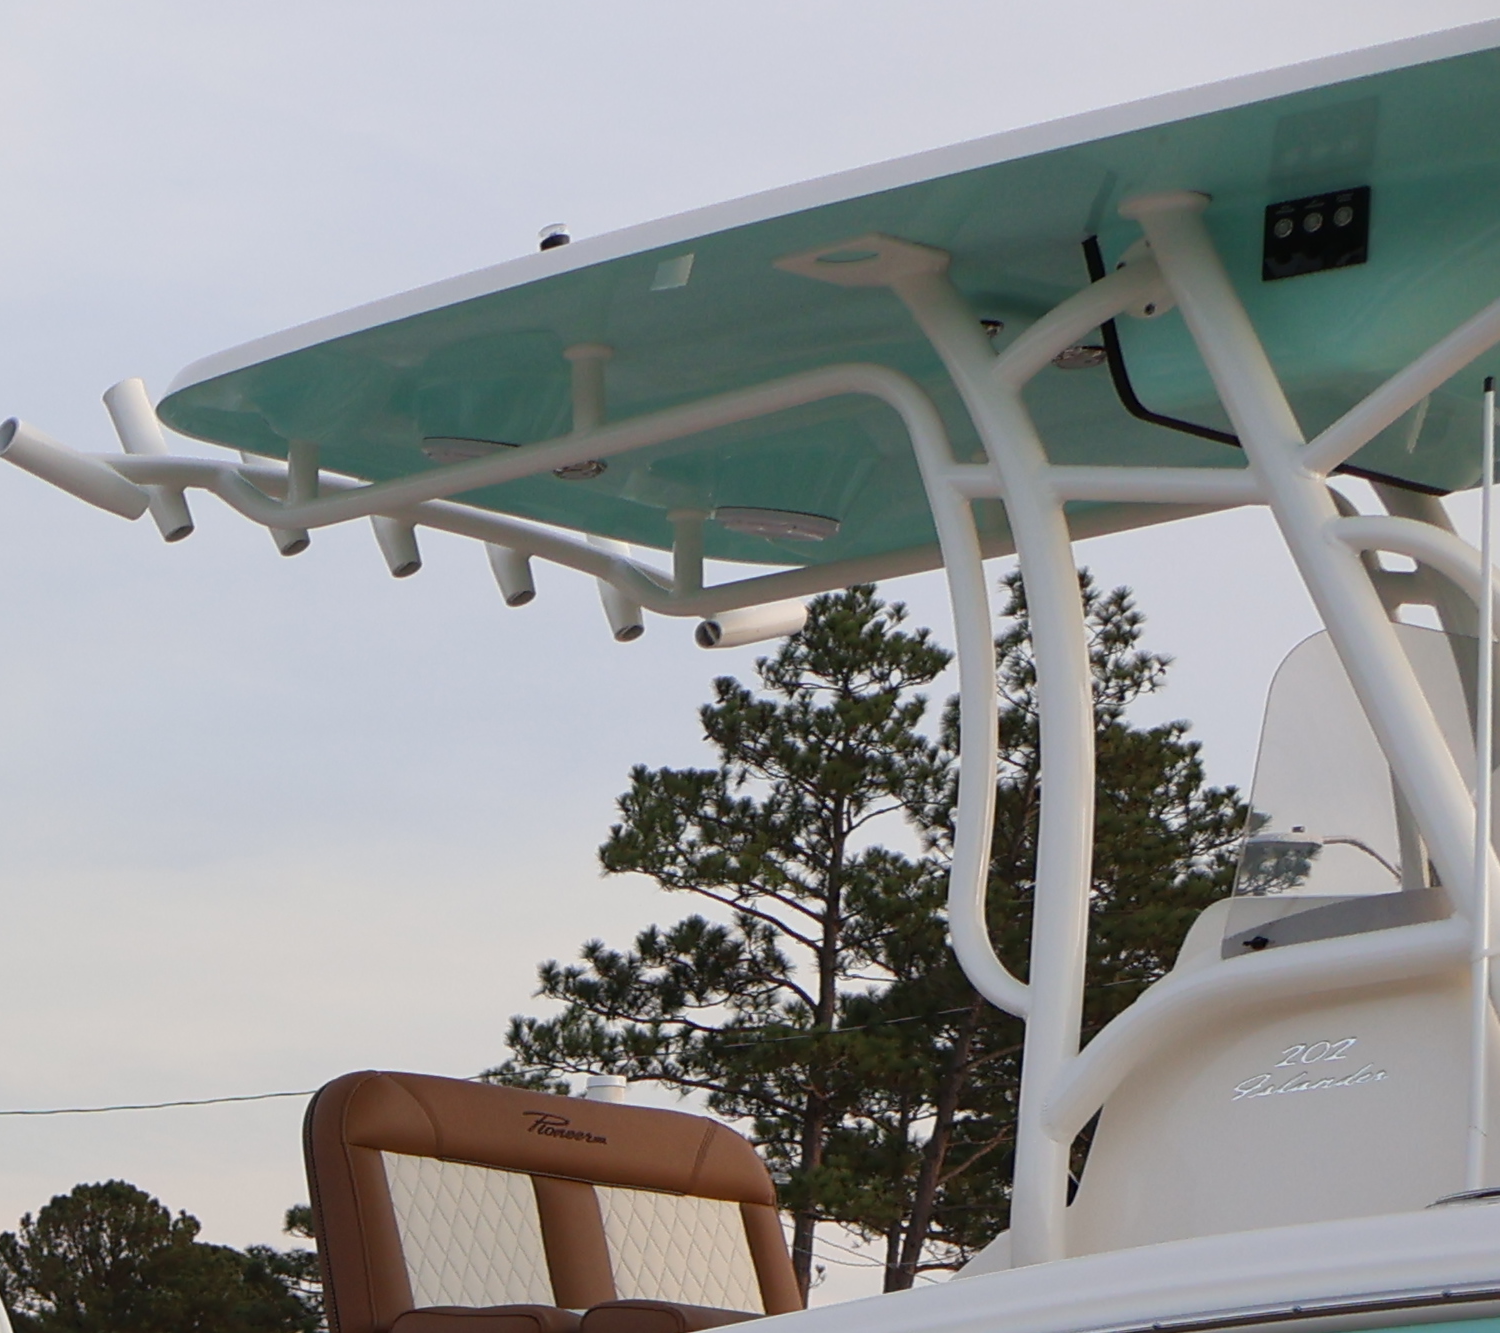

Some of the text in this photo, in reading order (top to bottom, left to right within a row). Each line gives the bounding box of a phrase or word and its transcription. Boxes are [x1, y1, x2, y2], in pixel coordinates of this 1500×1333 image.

[1274, 1036, 1357, 1068] 202
[1231, 1062, 1389, 1101] Islander
[522, 1110, 596, 1143] Pioneer
